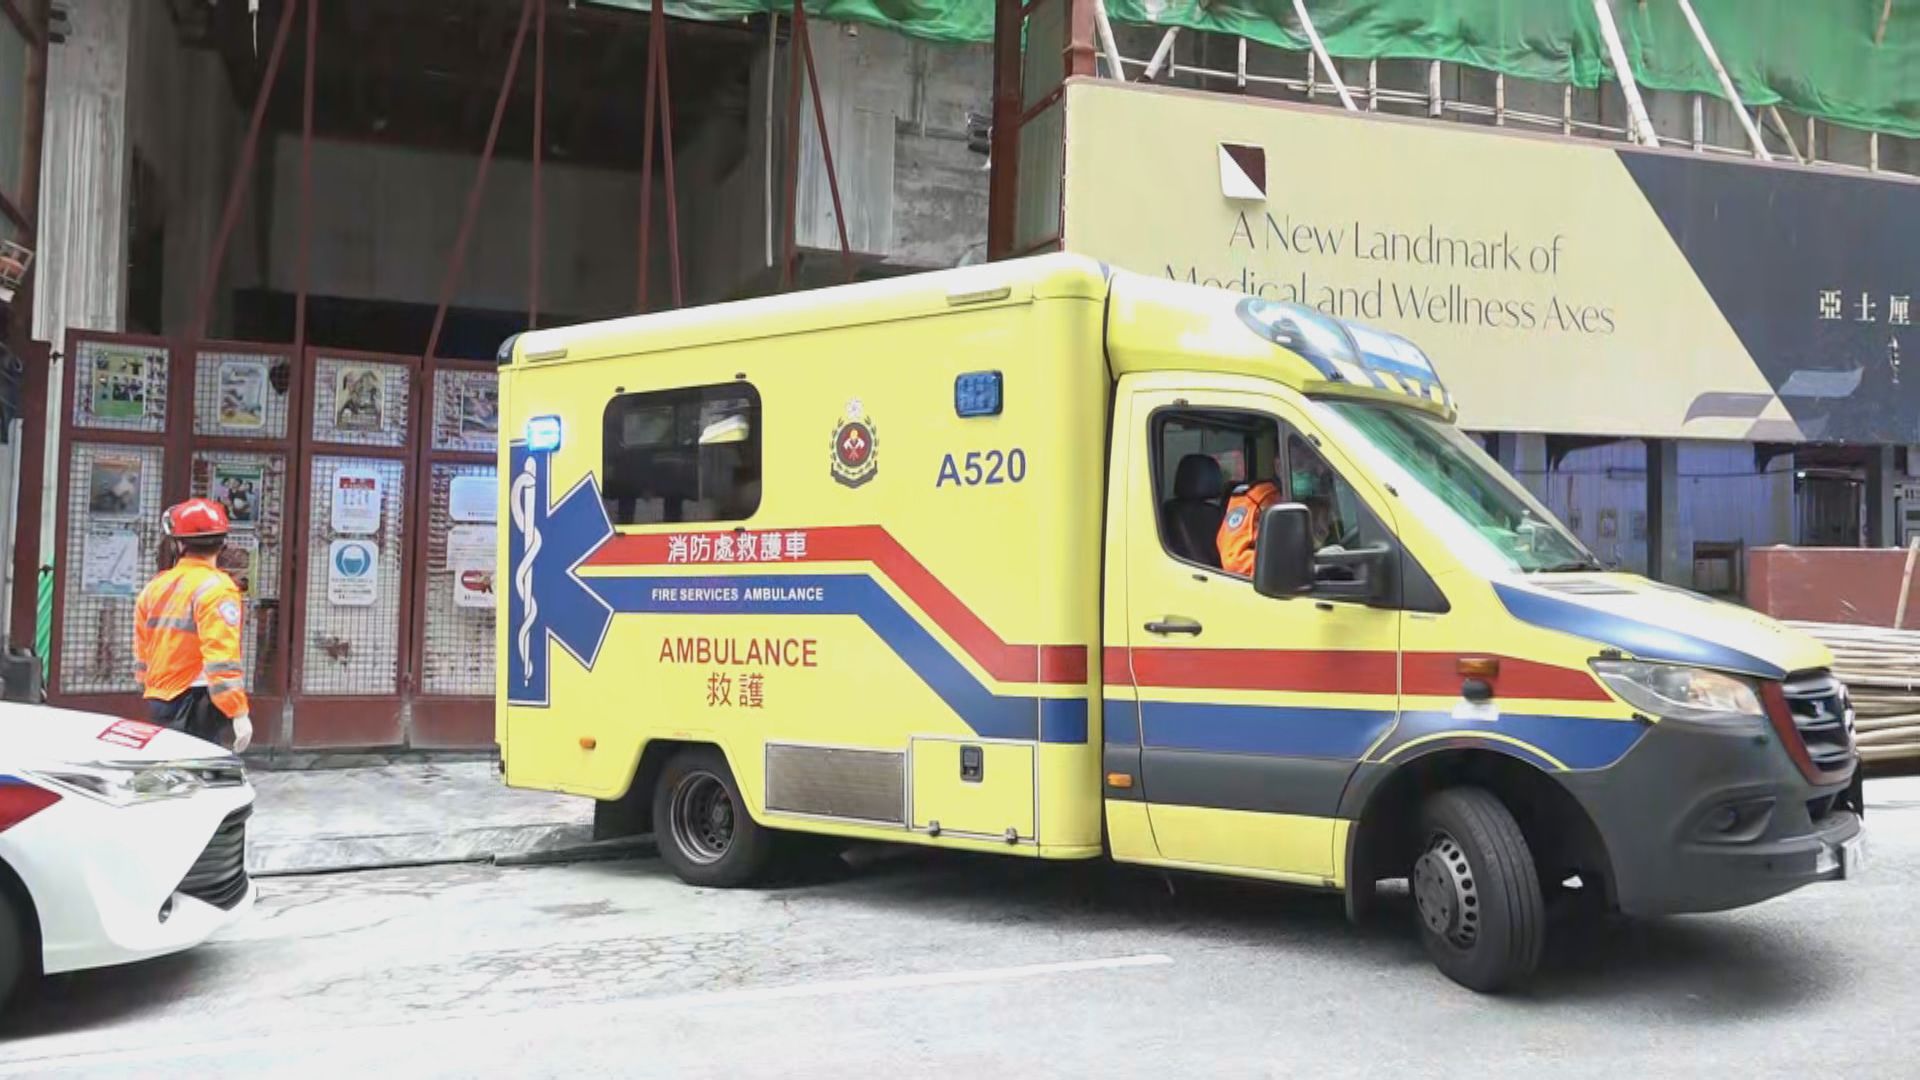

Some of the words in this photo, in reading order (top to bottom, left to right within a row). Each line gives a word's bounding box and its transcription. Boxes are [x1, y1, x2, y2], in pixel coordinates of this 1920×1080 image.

[1229, 210, 1255, 250] A
[1265, 211, 1345, 255] New
[1355, 220, 1521, 272] Landmark
[1529, 235, 1565, 275] of
[1317, 278, 1382, 319] and
[1391, 282, 1536, 330] Wellness
[1543, 297, 1616, 334] Axes
[936, 448, 1026, 487] A520
[668, 531, 808, 563] 消防處救護車
[652, 588, 677, 601] FIRE
[679, 588, 739, 601] SERVICES
[744, 587, 824, 601] AMBULANCE
[659, 637, 818, 667] AMBULANCE
[706, 672, 764, 709] 救護
